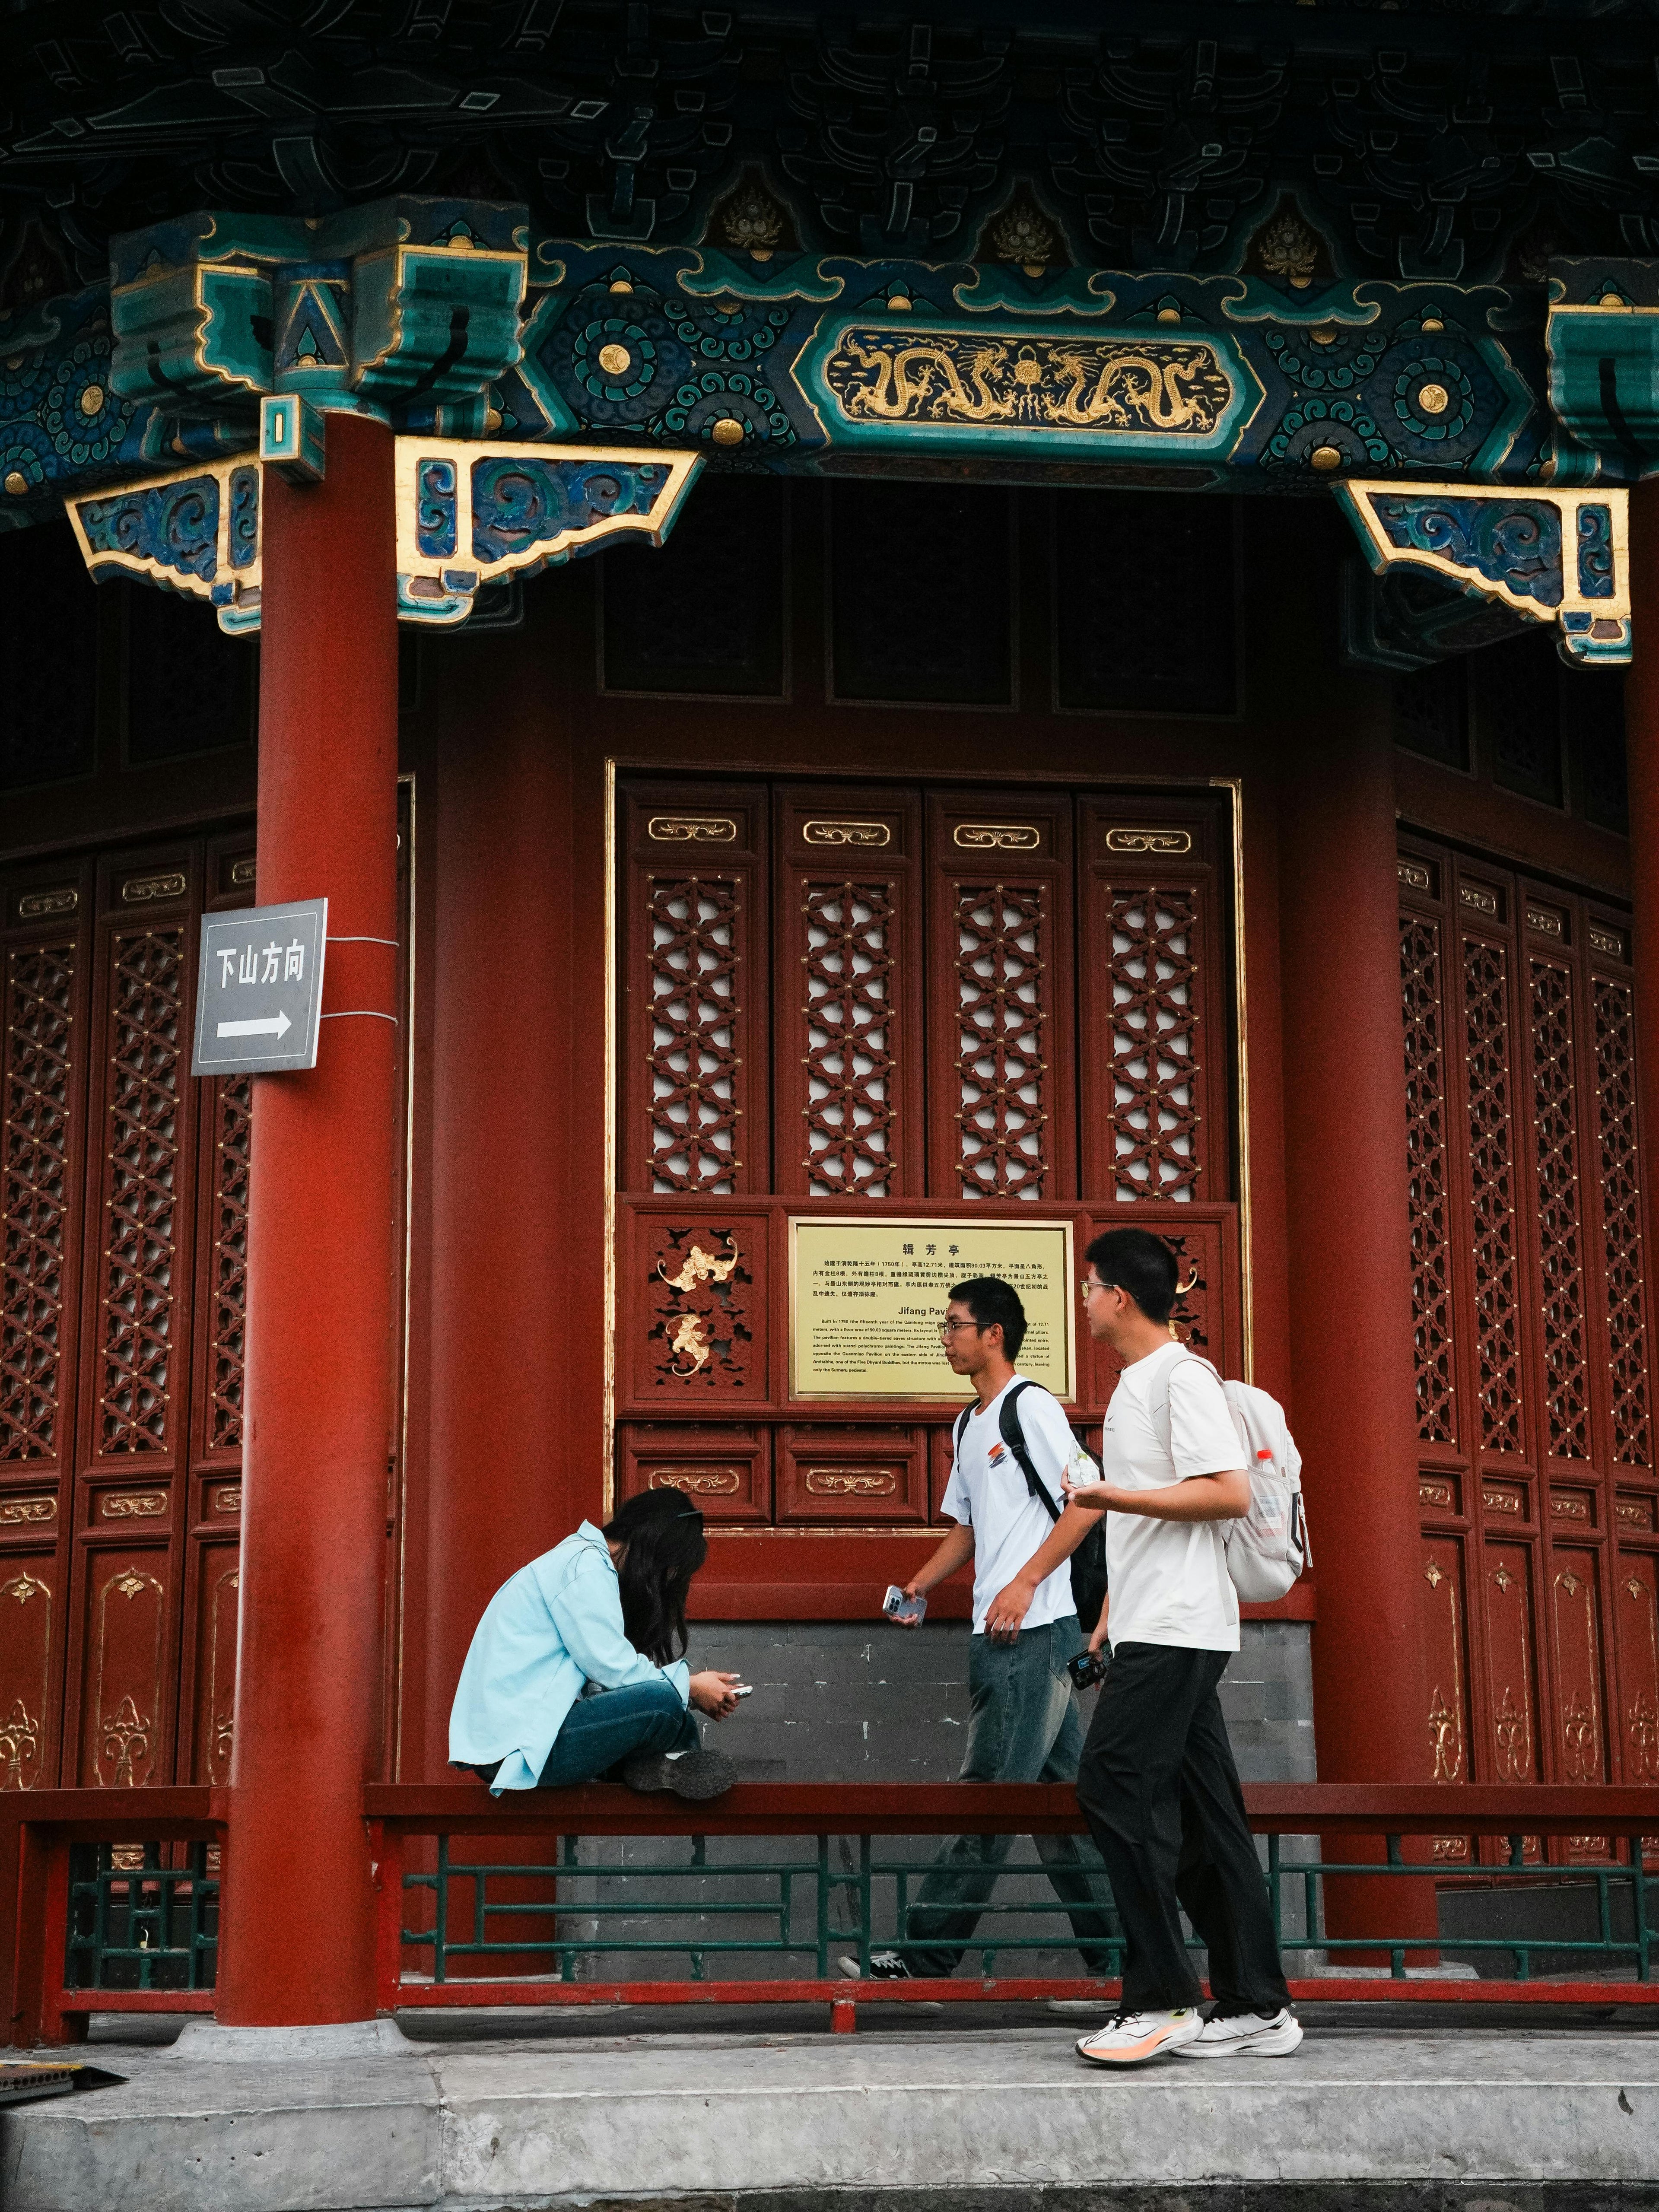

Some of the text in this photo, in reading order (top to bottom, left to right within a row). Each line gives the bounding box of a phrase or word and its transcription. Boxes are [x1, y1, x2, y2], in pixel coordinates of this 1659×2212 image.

[216, 938, 305, 988] 下山方向
[903, 1244, 959, 1256] 辑芳亭
[898, 1307, 926, 1316] Jifang
